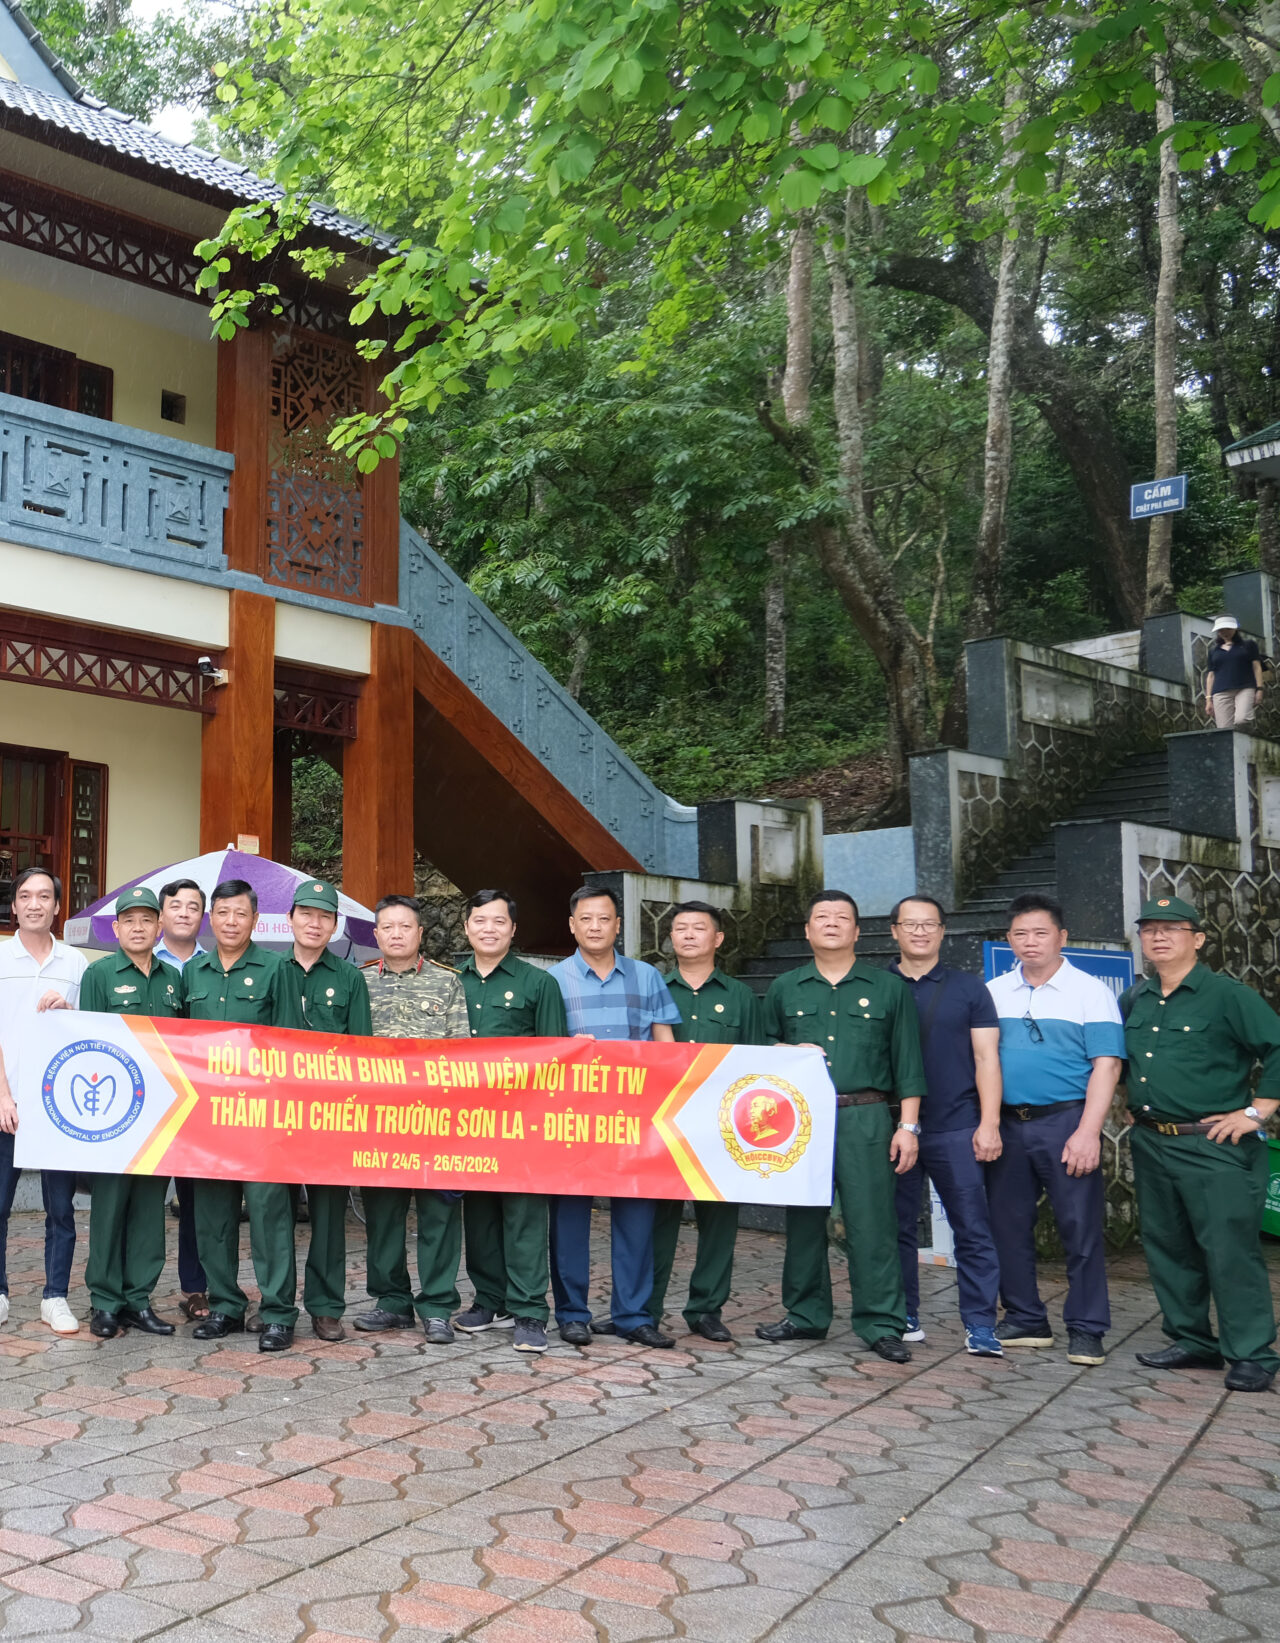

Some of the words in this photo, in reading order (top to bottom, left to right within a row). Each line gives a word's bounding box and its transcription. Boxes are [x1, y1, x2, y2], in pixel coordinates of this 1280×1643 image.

[1144, 484, 1171, 500] CẤM
[46, 1060, 61, 1080] BỆNH
[58, 1048, 74, 1061] VIỆN
[75, 1043, 88, 1052] NỘI
[107, 1046, 130, 1064] TRUNG
[207, 1040, 241, 1082] HỘI
[248, 1047, 287, 1084] CỰU
[293, 1046, 353, 1082] CHIẾN
[356, 1056, 407, 1085] BINH
[424, 1054, 479, 1093] BỆNH
[483, 1056, 529, 1095] VIỆN
[532, 1056, 566, 1097] NỘI
[571, 1056, 611, 1093] TIẾT
[616, 1065, 647, 1095] TW
[44, 1095, 61, 1125] NATIONAL
[60, 1123, 91, 1140] HOSPITAL
[101, 1100, 142, 1140] ENDOCRINOLOGY
[209, 1091, 267, 1128] THĂM
[273, 1099, 304, 1136] LẠI
[309, 1094, 369, 1133] CHIẾN
[374, 1100, 451, 1136] TRƯỜNG
[456, 1106, 496, 1138] SƠN
[501, 1110, 525, 1140] LA
[543, 1107, 590, 1148] ĐIỆN
[595, 1109, 641, 1145] BIÊN
[352, 1148, 388, 1169] NGÀY
[392, 1152, 420, 1170] 24/5
[433, 1154, 499, 1174] 26/5/2024
